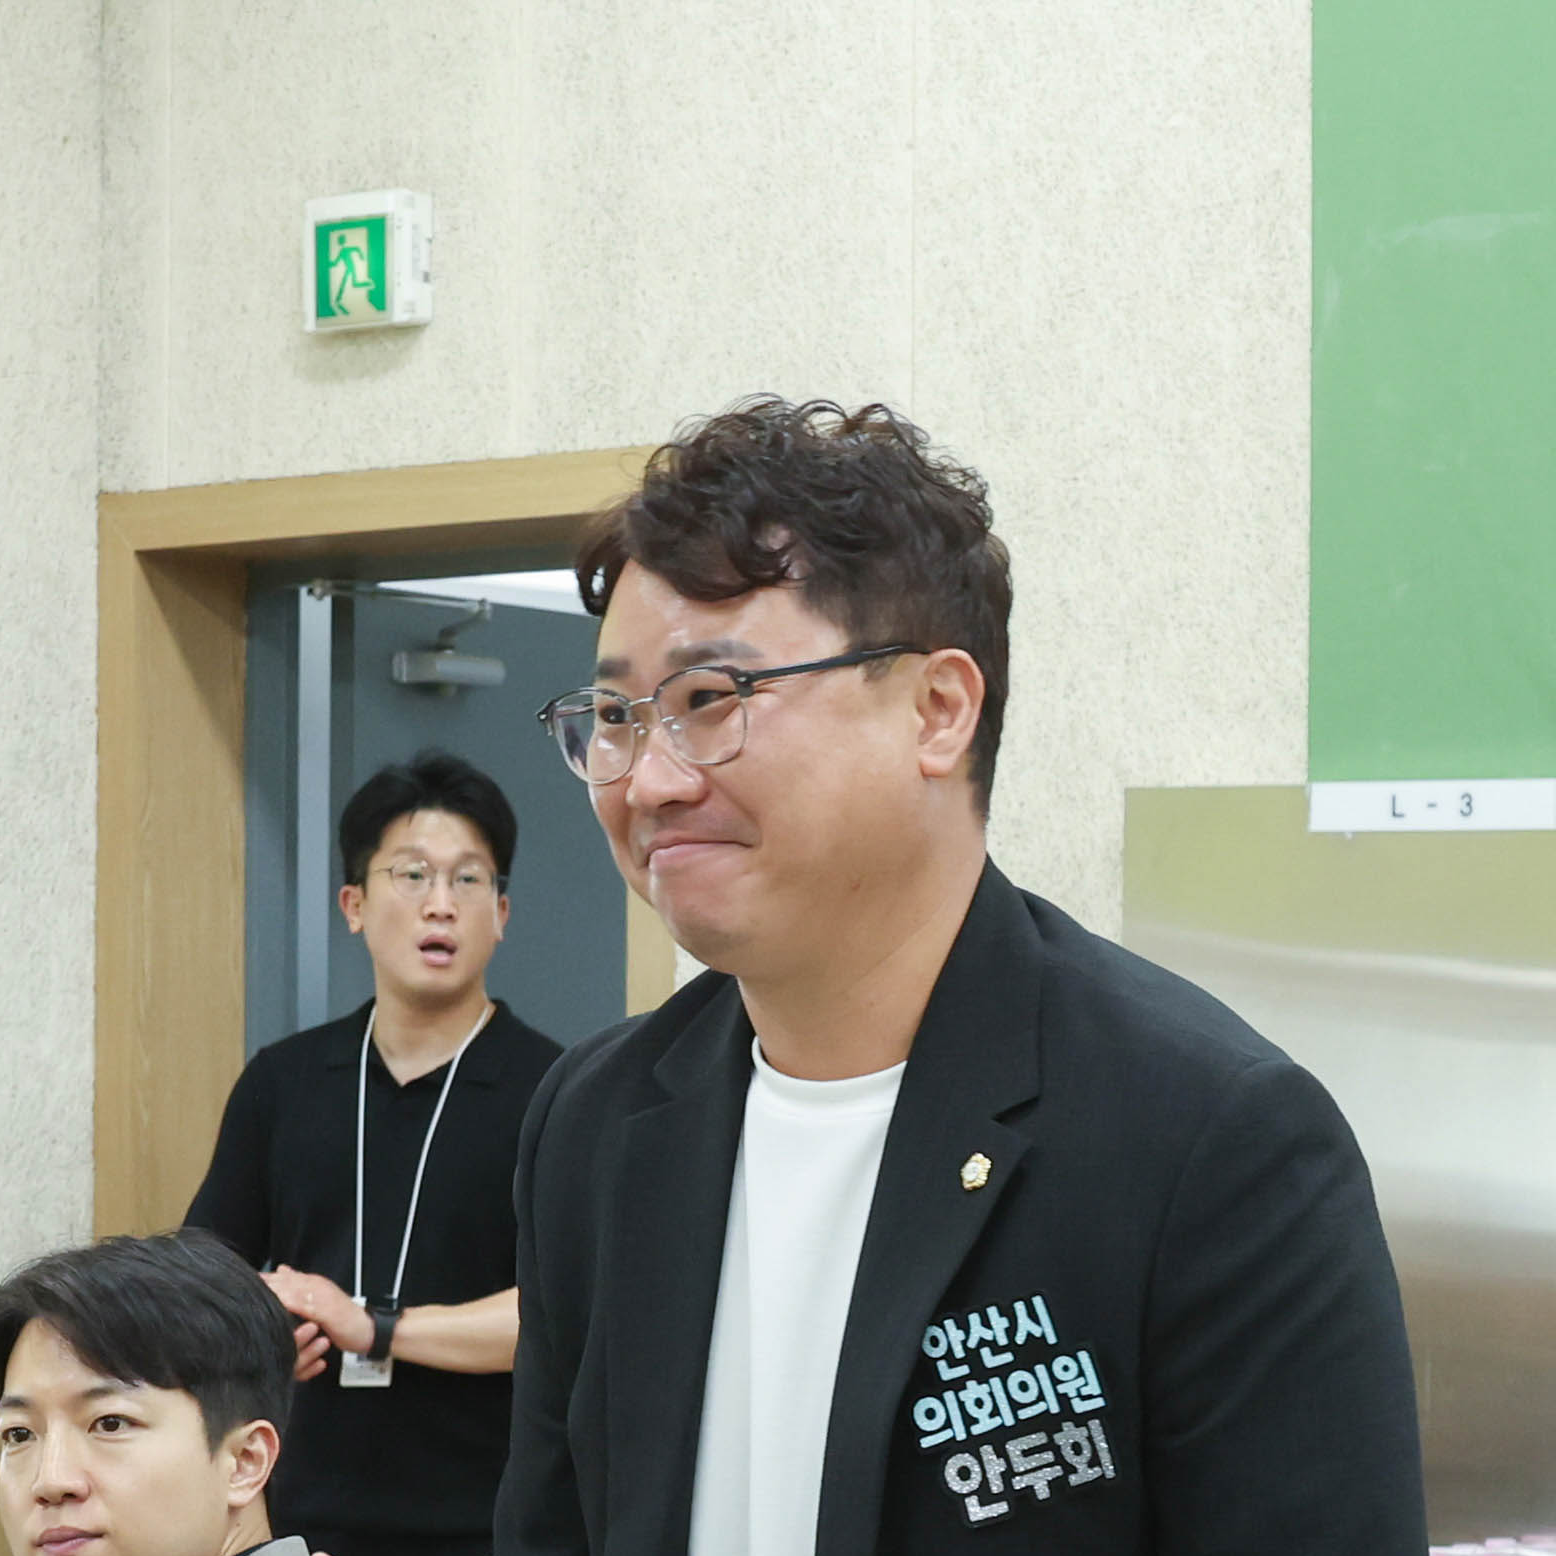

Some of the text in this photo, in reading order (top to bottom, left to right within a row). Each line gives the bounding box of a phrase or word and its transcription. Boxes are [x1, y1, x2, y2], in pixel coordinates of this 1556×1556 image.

[922, 1295, 1058, 1381] 안산시
[912, 1350, 1105, 1448] 의회의원
[943, 1418, 1116, 1521] 안두회
